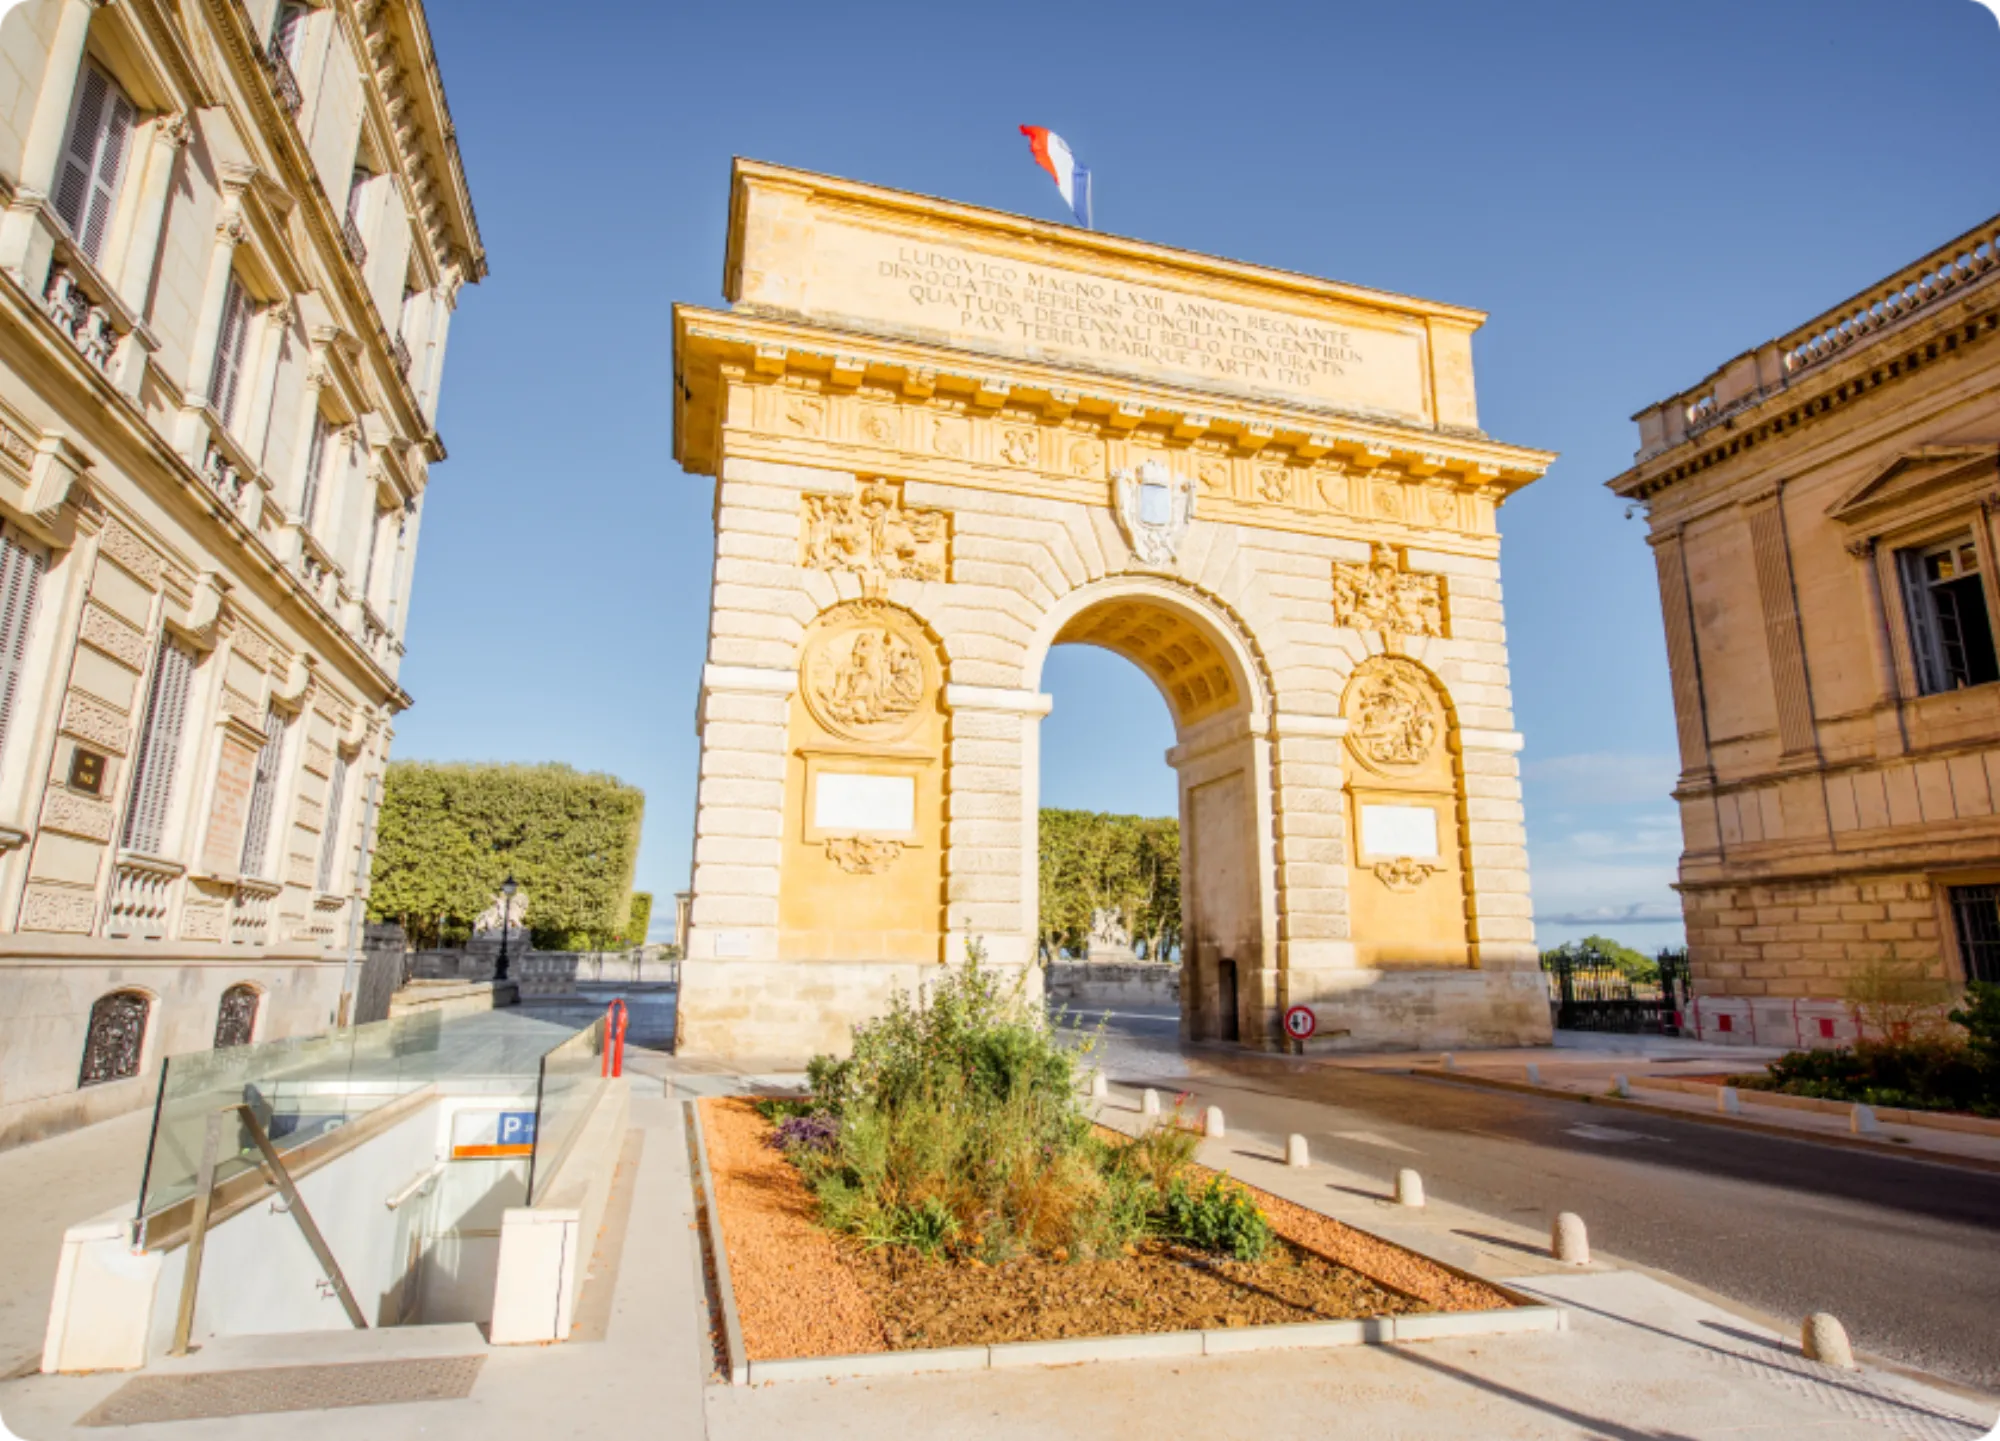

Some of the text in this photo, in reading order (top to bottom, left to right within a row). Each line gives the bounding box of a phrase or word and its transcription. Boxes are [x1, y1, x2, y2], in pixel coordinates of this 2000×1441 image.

[878, 261, 1013, 298] DISSOCIATIS
[1266, 335, 1363, 362] GENTIBUS
[899, 247, 1018, 282] LUDOVICO
[1028, 272, 1105, 299] MAGNO
[1247, 315, 1352, 347] REGNANTE
[909, 285, 1023, 318] QUATUOR
[1035, 306, 1151, 341] DECENNALI
[1160, 330, 1221, 353] BELLO
[961, 311, 1005, 333] PAX
[1017, 321, 1089, 348] TERRA
[1201, 354, 1268, 379] PARTA
[503, 1117, 521, 1141] P
